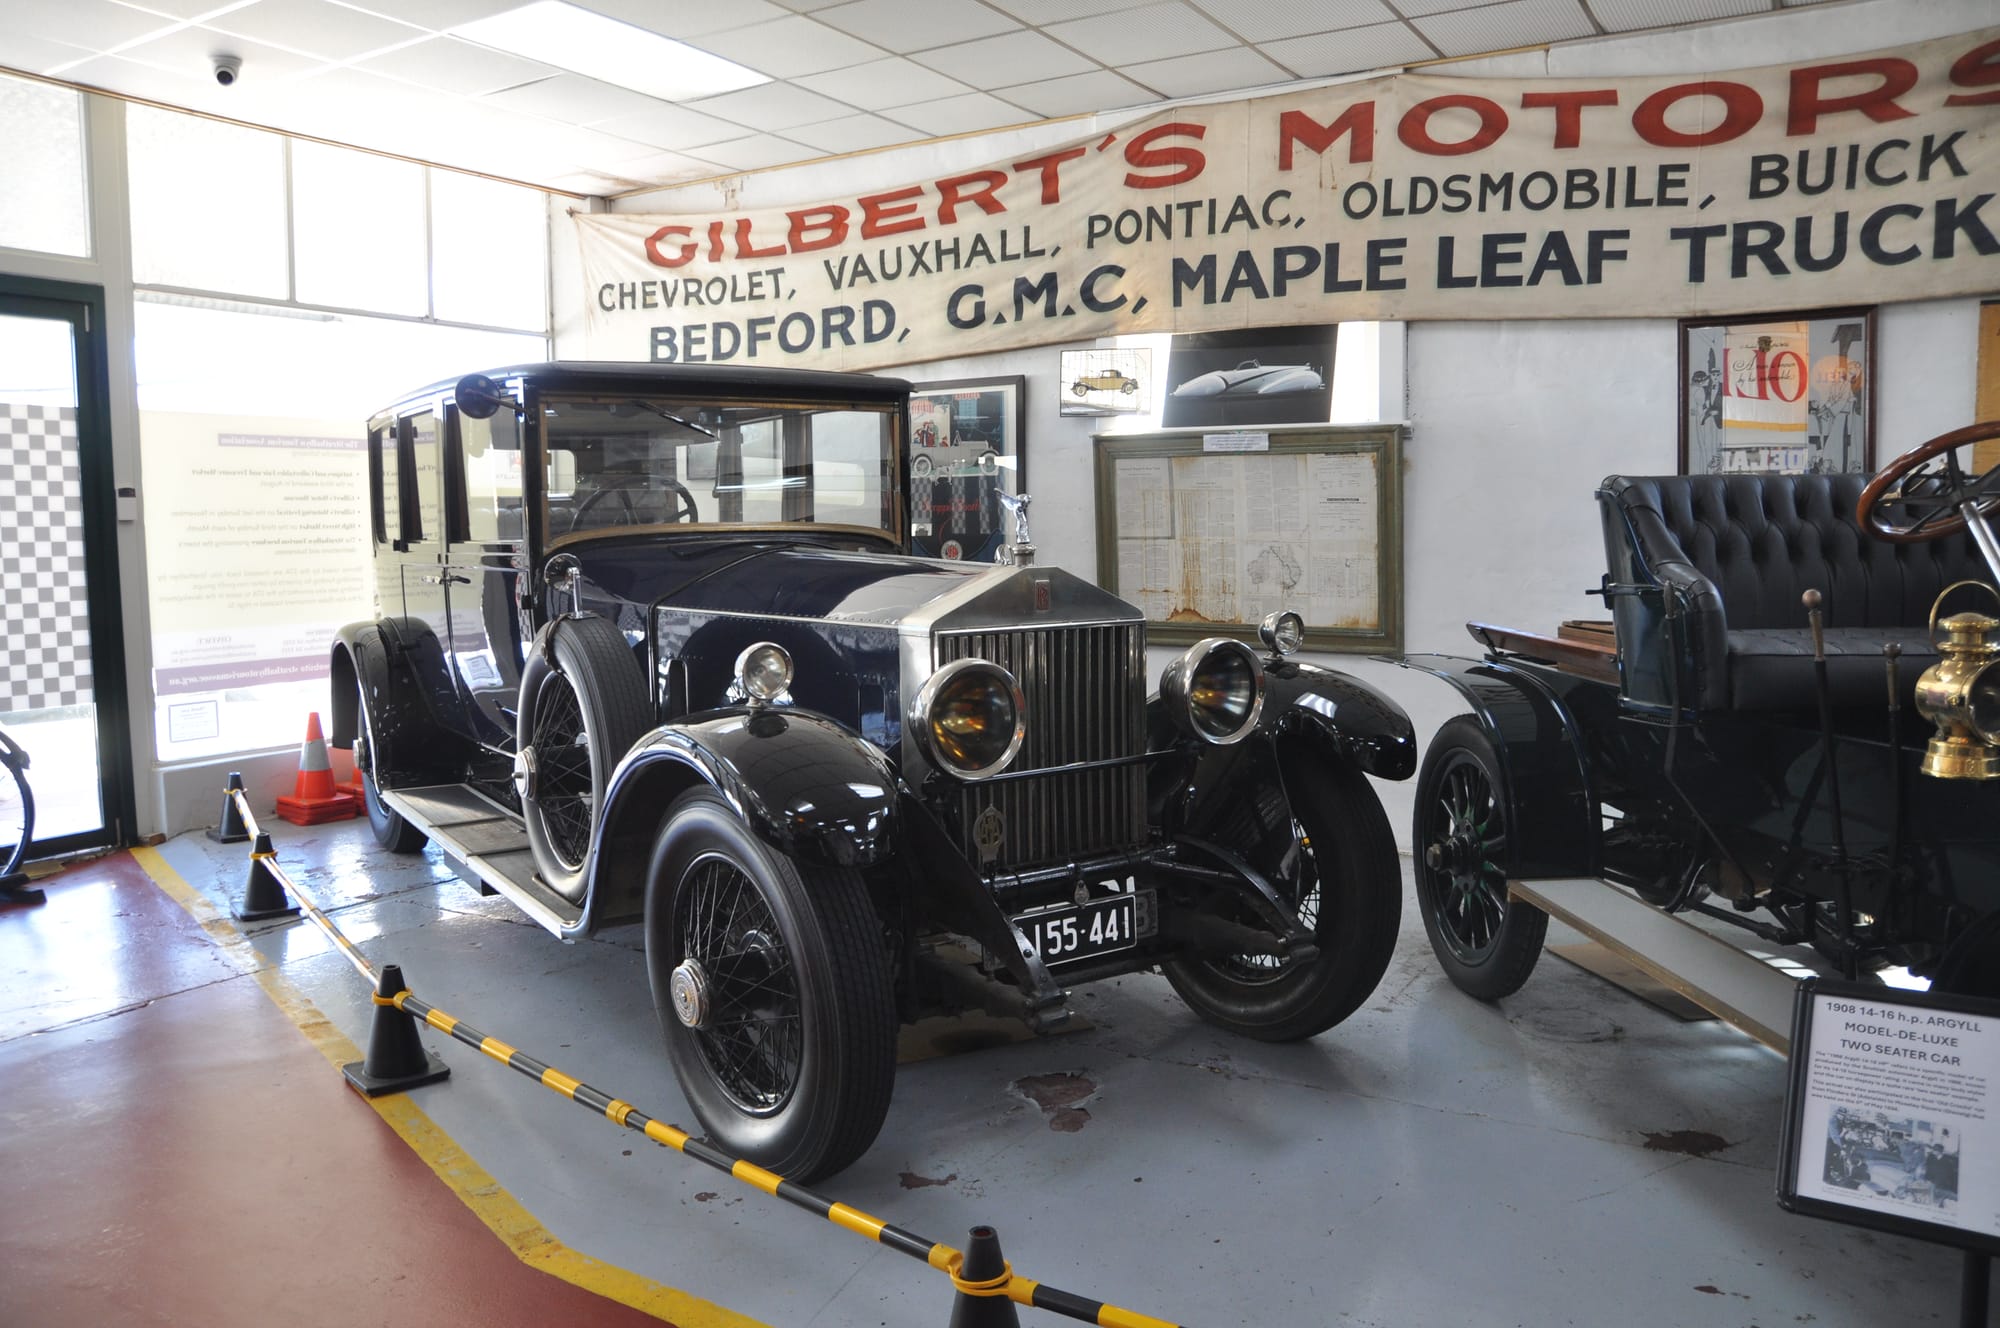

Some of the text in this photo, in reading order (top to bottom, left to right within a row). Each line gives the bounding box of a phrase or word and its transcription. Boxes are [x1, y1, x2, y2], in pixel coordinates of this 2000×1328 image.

[598, 131, 1968, 312] CHEVROLET, VAUXHALL, PONTIAC, OLDSMOBILE, BUICK
[644, 124, 1205, 269] GILBERT'S
[650, 299, 911, 362] BEDFORD,
[1172, 238, 1426, 308] MAPLE
[1437, 230, 1630, 289] LEAF
[1670, 193, 2000, 283] TRUCK
[1826, 1002, 1982, 1032] 1908 14-16 h.p. ARGYLL
[1840, 1039, 1961, 1066] TWO SEATER CAR
[1844, 1022, 1959, 1047] MODEL-DE-LUXE
